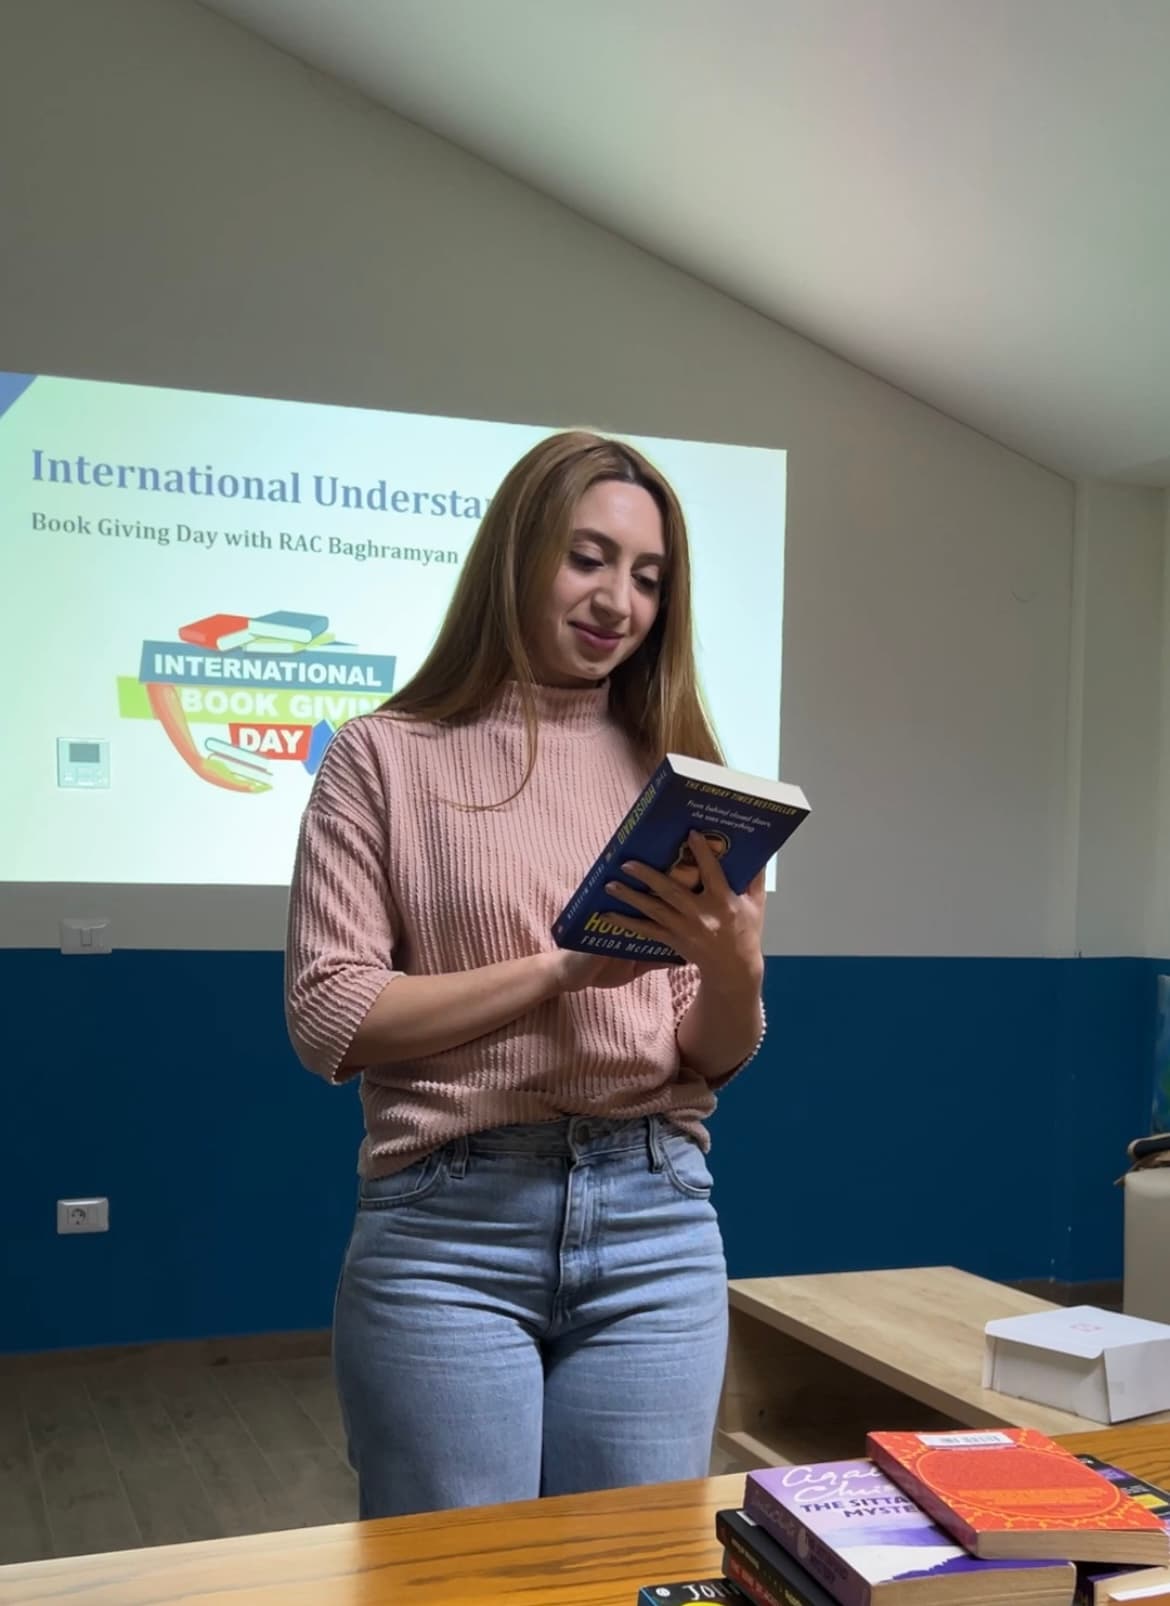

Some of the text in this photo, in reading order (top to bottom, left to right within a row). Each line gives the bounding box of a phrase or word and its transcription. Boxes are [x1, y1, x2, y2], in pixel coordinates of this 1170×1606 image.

[32, 449, 302, 504] International
[32, 512, 459, 566] Book Giving Day with RAC Baghramyan
[154, 654, 382, 687] INTERNATIONAL
[181, 688, 383, 720] BOOK GIVIN
[238, 727, 304, 754] DAY
[617, 783, 657, 845] HOUSEMAID
[580, 935, 622, 949] FREIDA
[801, 1496, 910, 1513] THE SITTA
[844, 1505, 918, 1518] MYSTE
